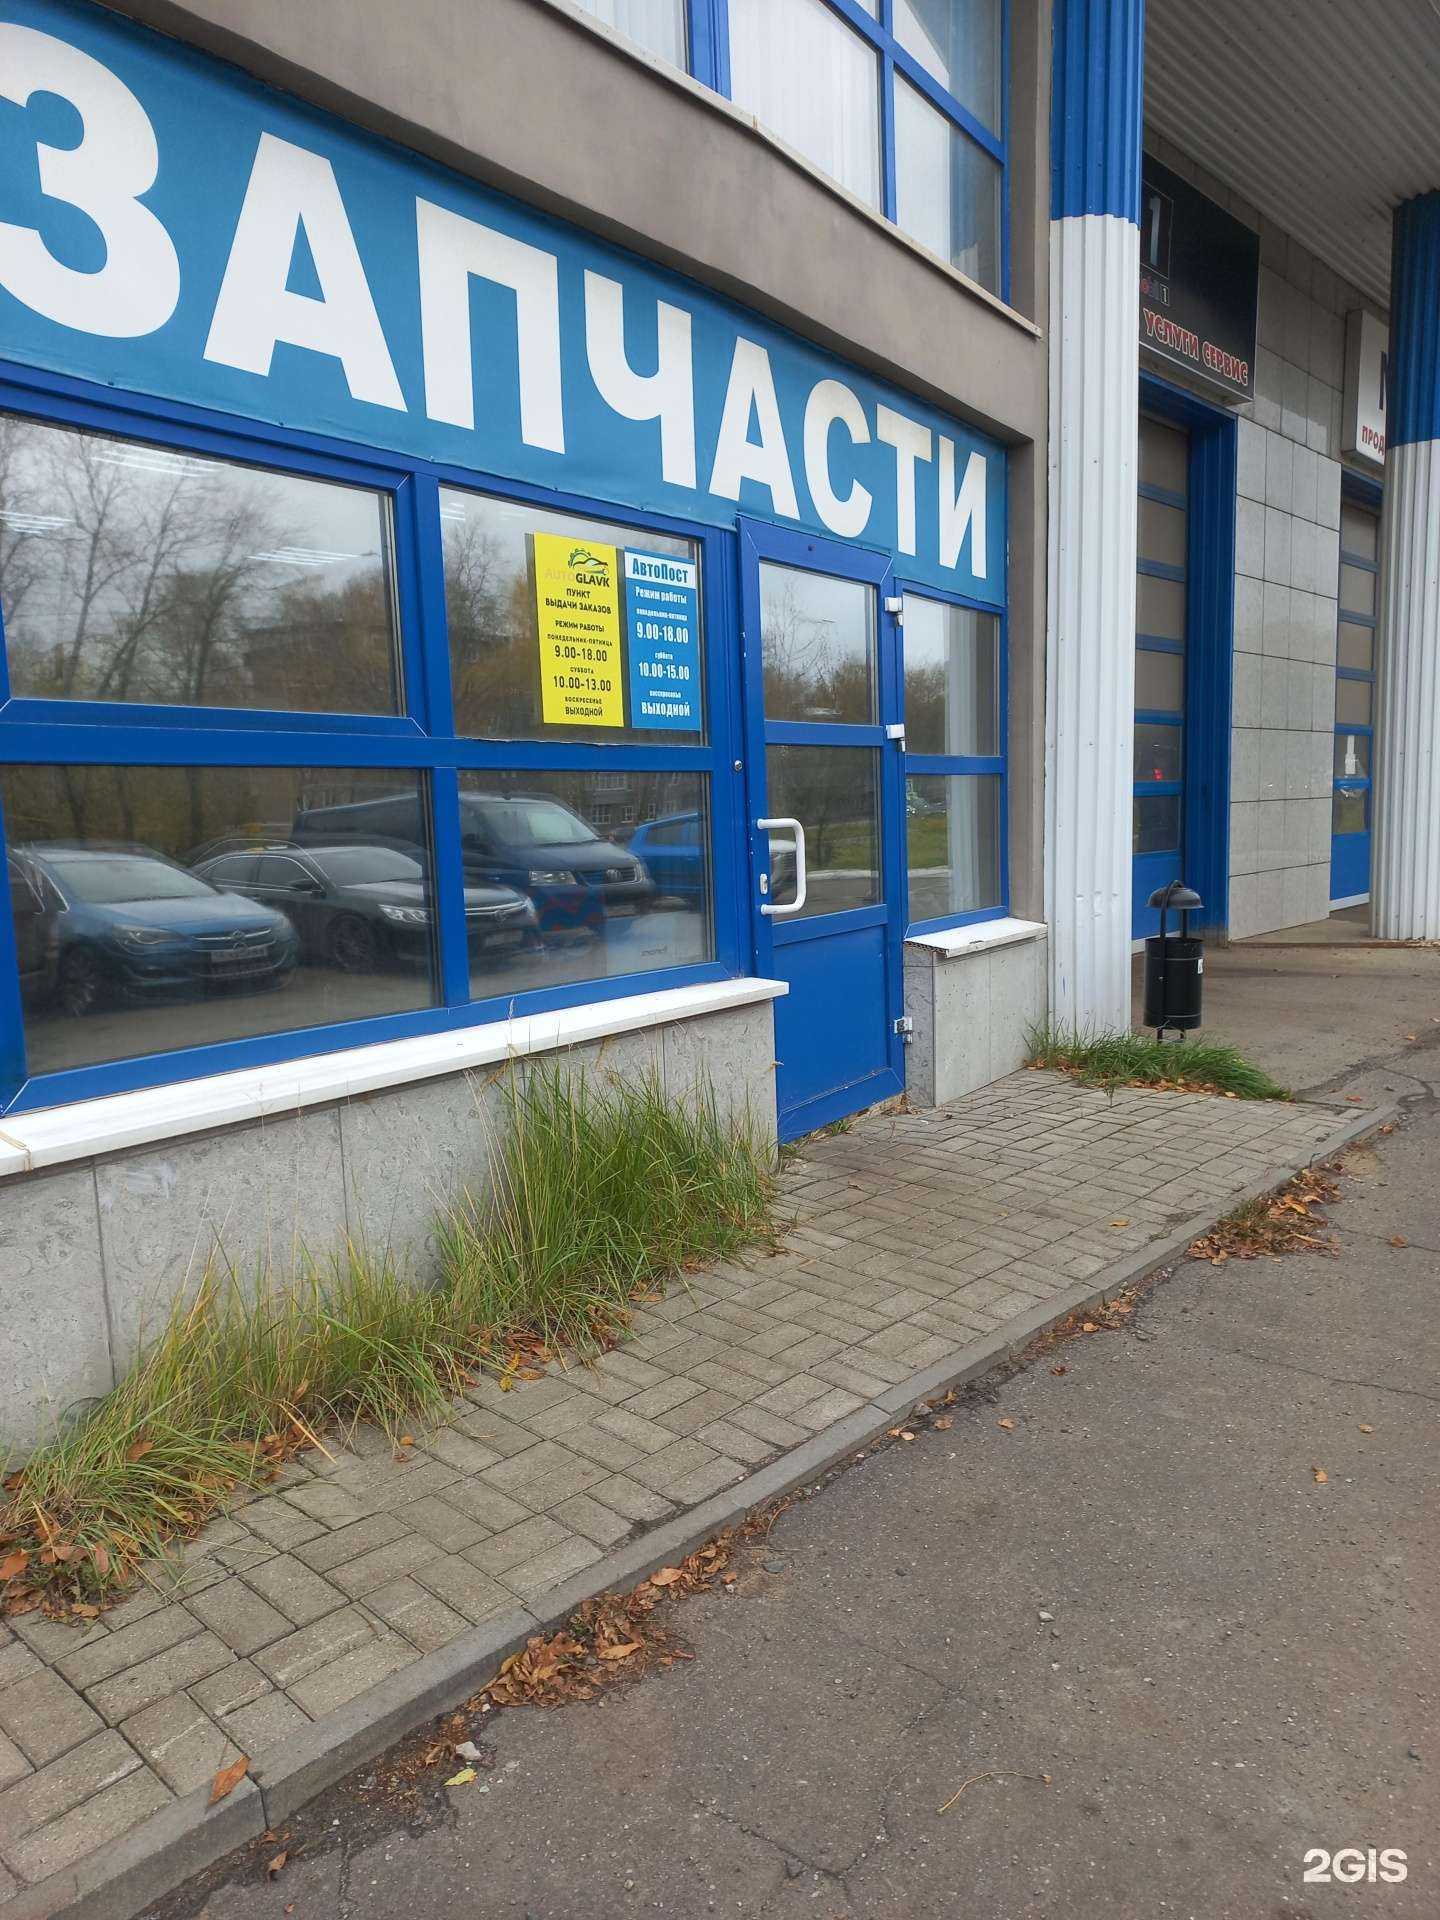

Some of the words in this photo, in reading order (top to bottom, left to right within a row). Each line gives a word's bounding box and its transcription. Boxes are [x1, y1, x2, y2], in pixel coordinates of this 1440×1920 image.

[0, 22, 988, 578] ЗАПЧАСТИ
[1143, 307, 1200, 361] УСЛУГИ
[1201, 341, 1249, 386] СЕРВИС
[632, 558, 688, 584] АвтоПост
[566, 588, 591, 599] ПУНКТ
[635, 586, 660, 600] Режим
[545, 597, 578, 610] ВЫДАЧИ
[579, 602, 612, 615] ЗАКАЗОВ
[555, 619, 579, 630] РЕЖИМ
[579, 623, 605, 633] РАБОТЫ
[636, 621, 689, 643] 9.00-18.00
[554, 644, 608, 662] 9.00-18.00
[638, 661, 690, 680] 10.00-15.00
[553, 675, 611, 692] 10.00-13.00
[565, 706, 603, 717] ВЫХОДНОЙ
[641, 701, 690, 717] ВЫХОДНОЙ
